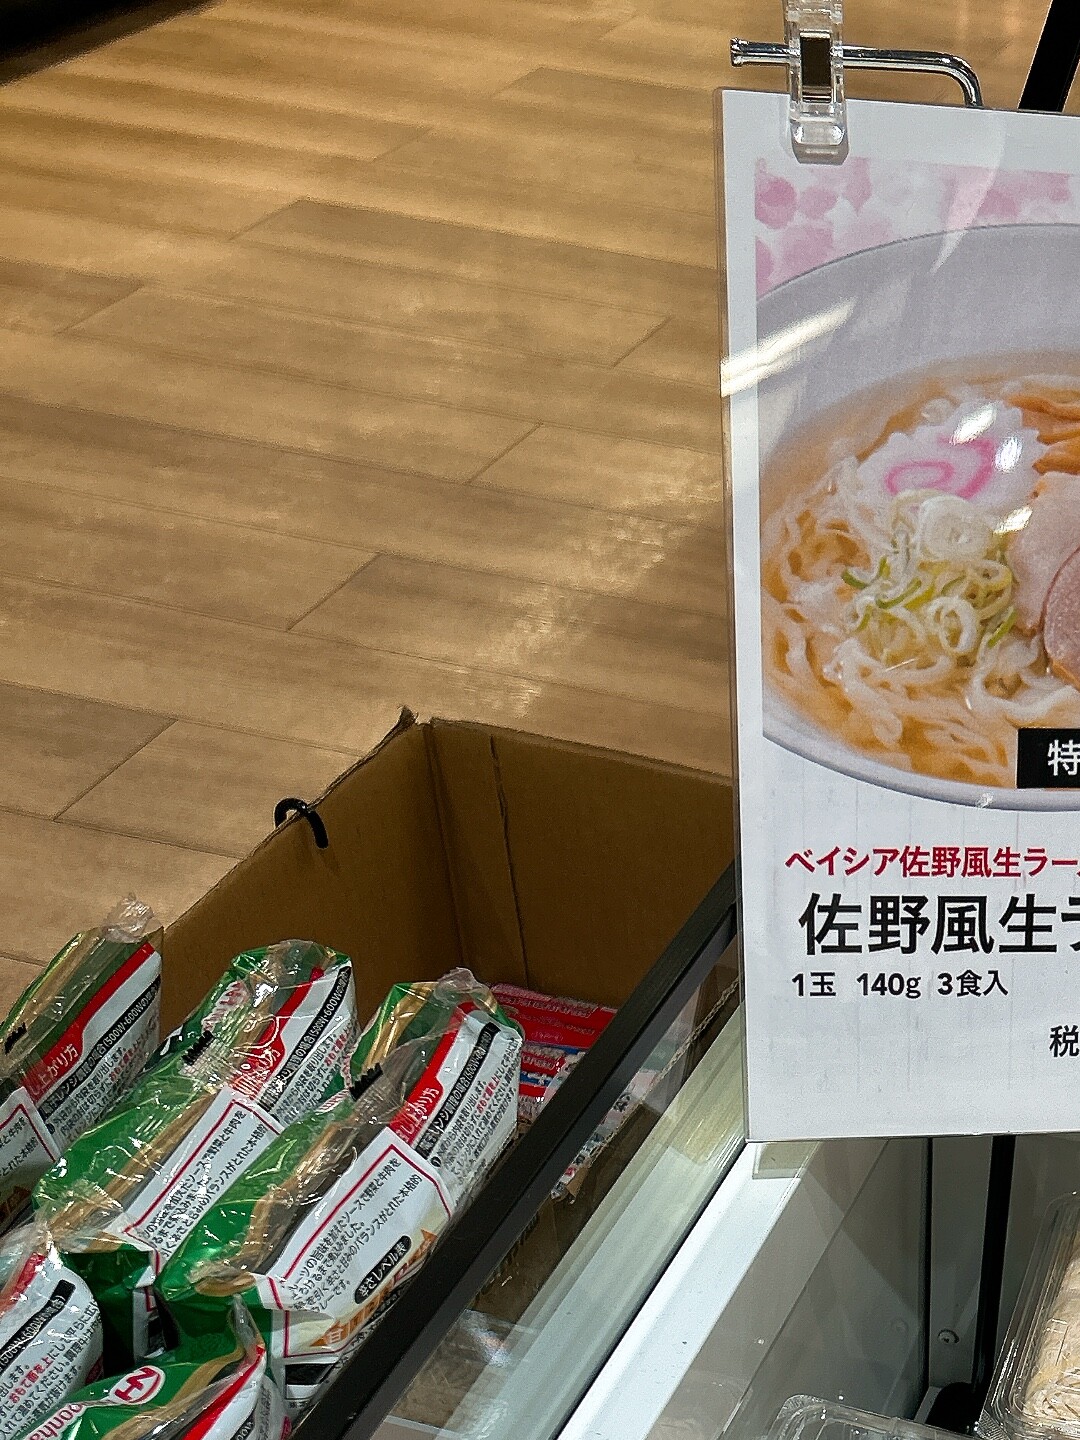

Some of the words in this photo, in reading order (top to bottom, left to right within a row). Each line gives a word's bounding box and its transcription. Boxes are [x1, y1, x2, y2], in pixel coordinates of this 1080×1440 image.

[793, 971, 836, 997] 1玉
[857, 972, 921, 1000] 140g
[938, 970, 1008, 997] 3食入
